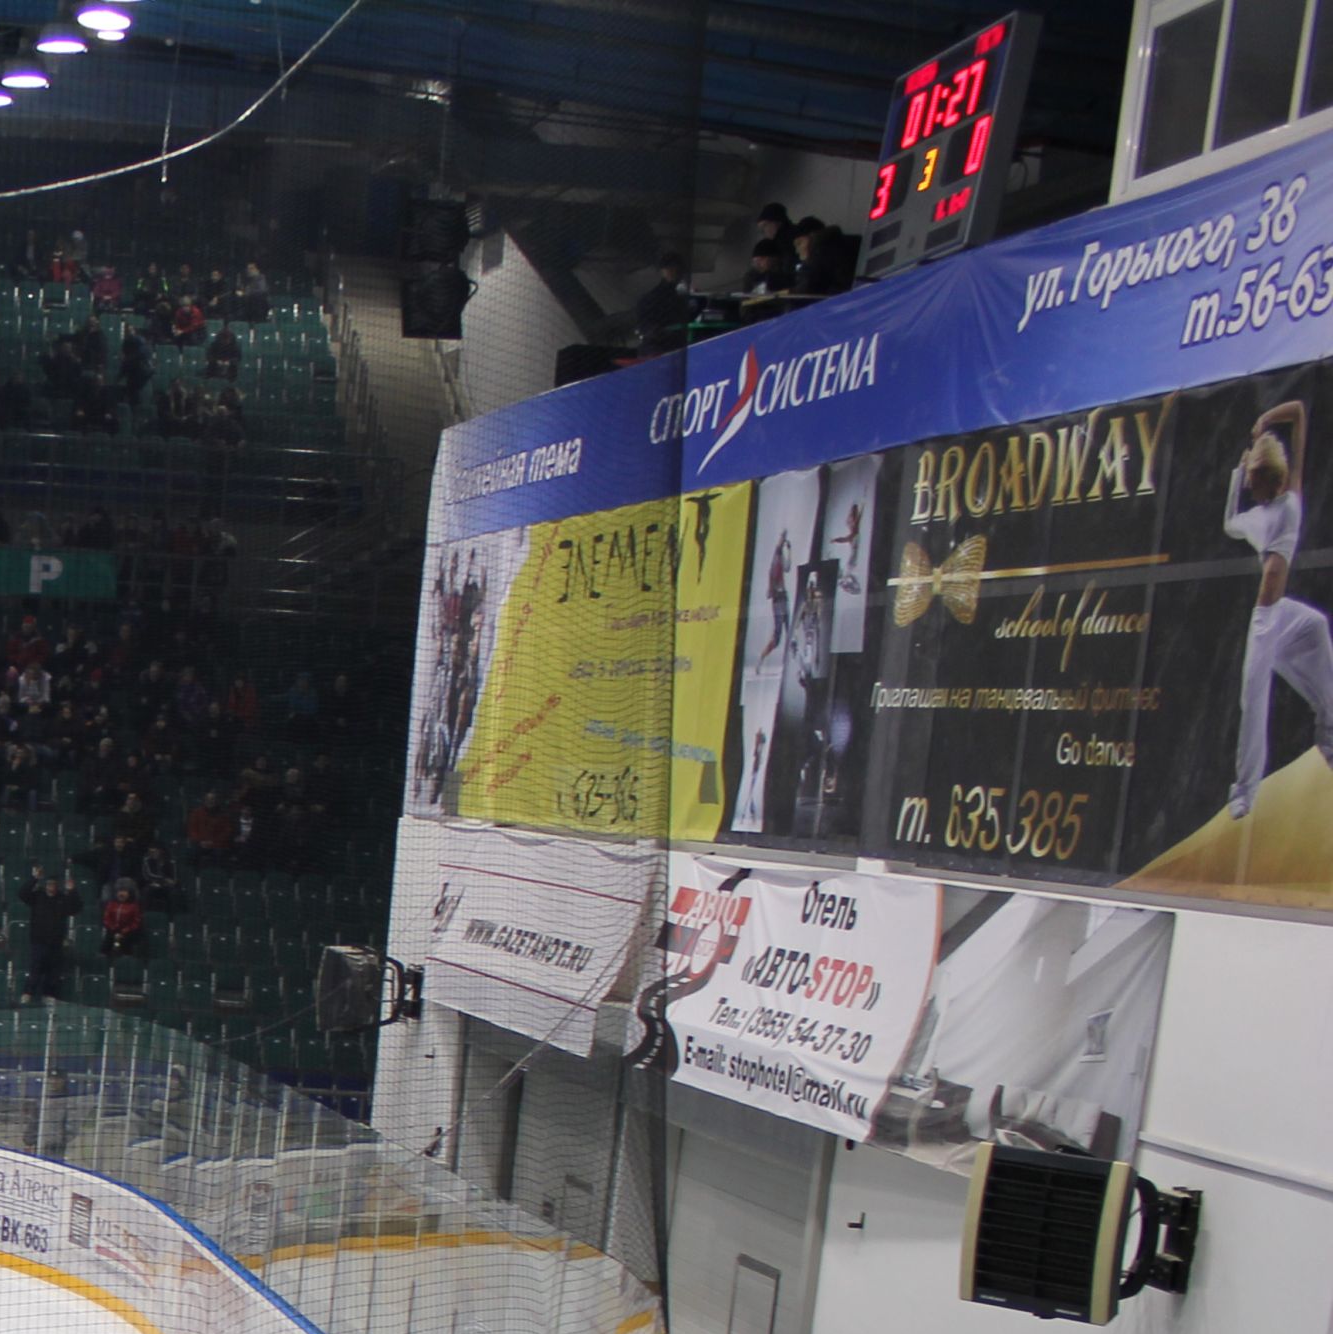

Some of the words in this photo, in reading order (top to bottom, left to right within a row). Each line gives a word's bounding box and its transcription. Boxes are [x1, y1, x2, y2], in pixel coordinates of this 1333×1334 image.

[900, 59, 988, 149] 01:27
[917, 148, 938, 191] 3
[963, 114, 993, 176] 0
[869, 163, 897, 220] 3
[1017, 266, 1065, 333] ул.
[1069, 213, 1238, 310] Горького,
[1246, 175, 1308, 252] 38
[649, 379, 730, 444] СПОРТ
[754, 332, 880, 417] СИСТЕМА
[527, 437, 582, 483] тема
[911, 391, 1179, 525] BROADWAY
[995, 584, 1062, 639] school
[1081, 590, 1151, 635] dance
[1056, 732, 1082, 765] Go
[1085, 733, 1136, 767] dance
[945, 784, 1005, 853] 635
[1006, 789, 1090, 861] 385
[800, 880, 858, 931] Отель
[738, 1006, 795, 1048] (3955)
[787, 1017, 874, 1064] 54-37-30
[684, 1035, 727, 1073] E-mail:
[729, 1053, 870, 1120] stophotel@mail.ru
[24, 1223, 49, 1253] 663
